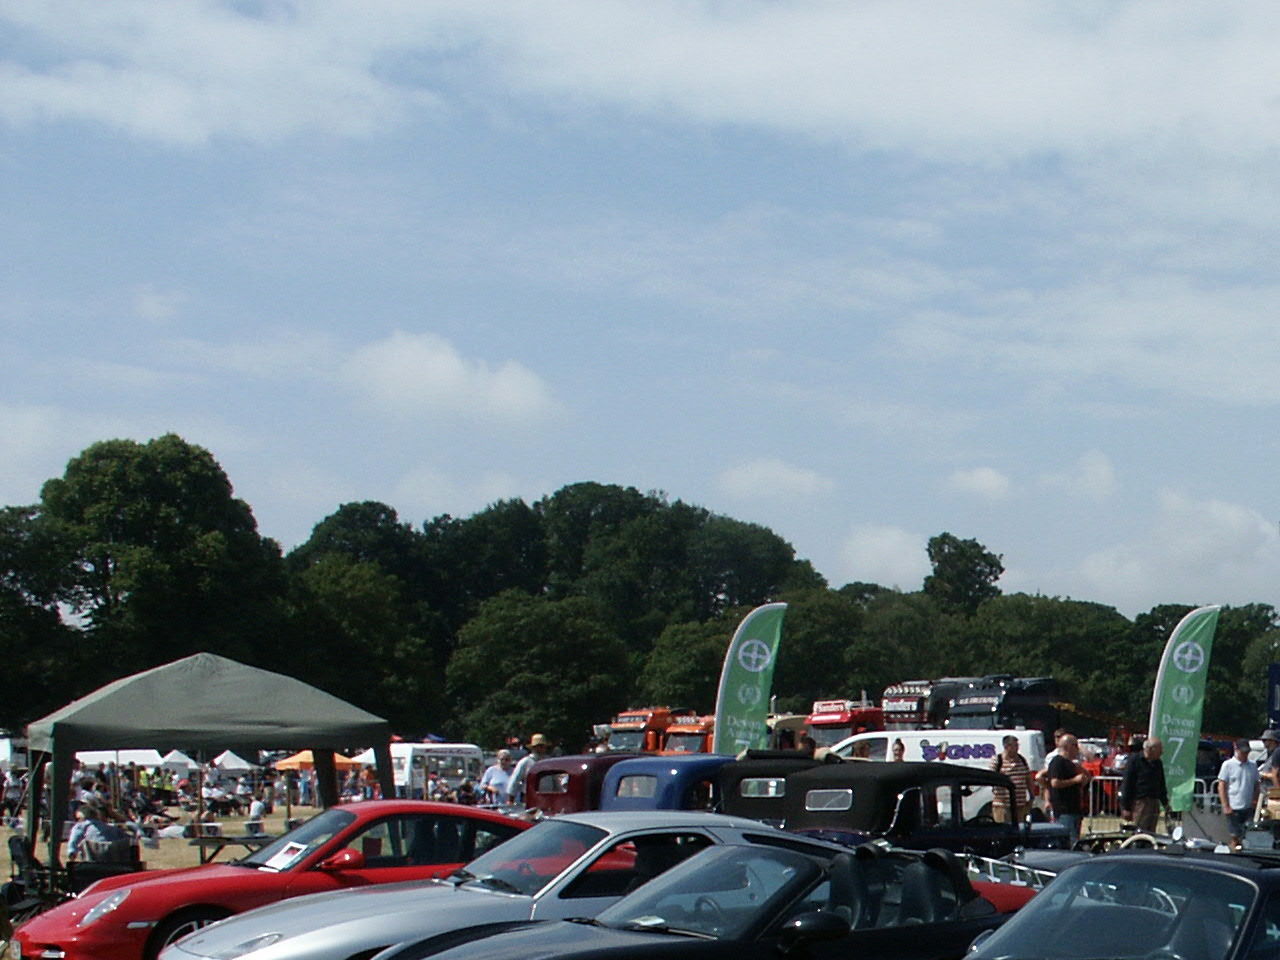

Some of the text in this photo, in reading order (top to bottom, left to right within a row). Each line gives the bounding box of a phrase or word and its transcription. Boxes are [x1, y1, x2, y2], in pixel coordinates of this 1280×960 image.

[1162, 713, 1195, 729] Devon
[1160, 724, 1195, 738] Austin
[1167, 737, 1185, 764] 7
